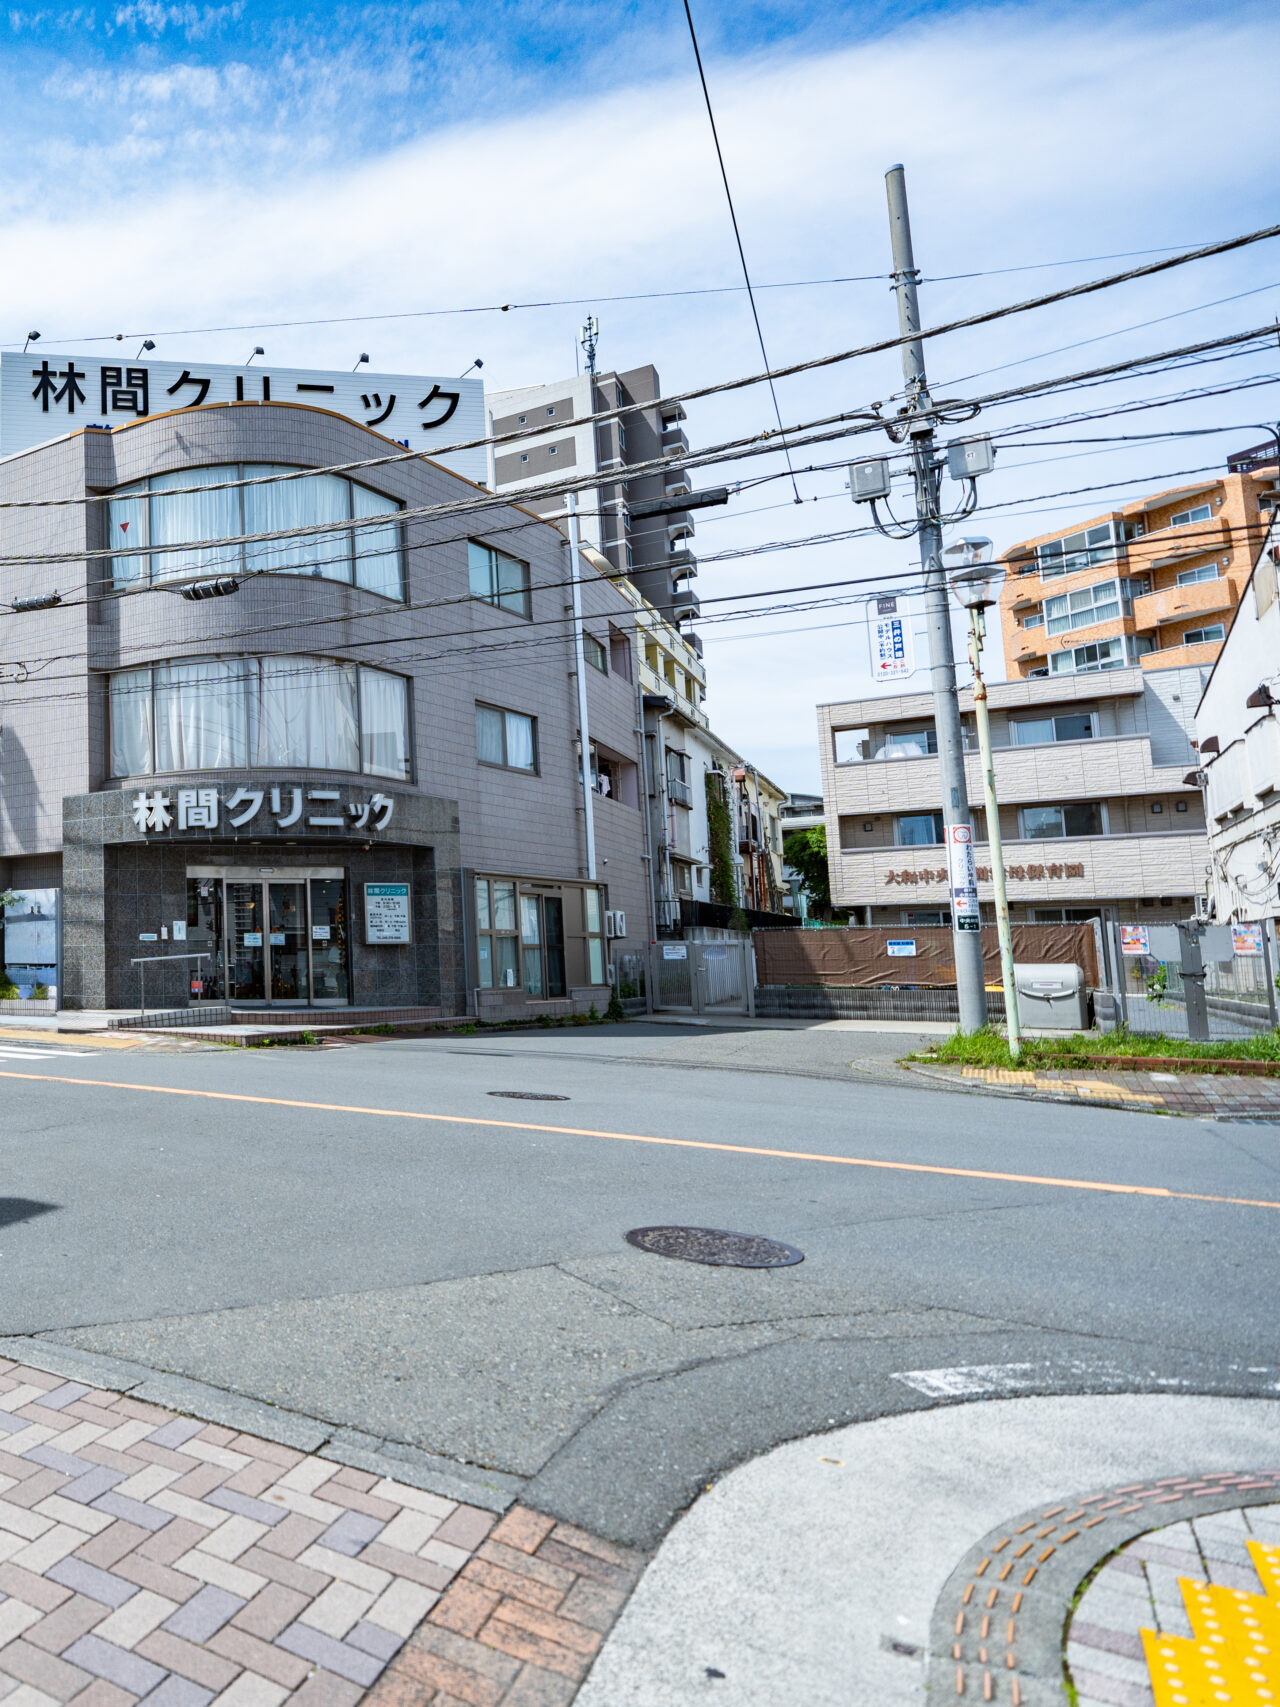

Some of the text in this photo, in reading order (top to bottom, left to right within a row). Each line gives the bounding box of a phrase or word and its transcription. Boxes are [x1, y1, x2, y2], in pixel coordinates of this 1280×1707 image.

[131, 786, 397, 833] 林間クリニック
[367, 887, 407, 895] 林間クリニック
